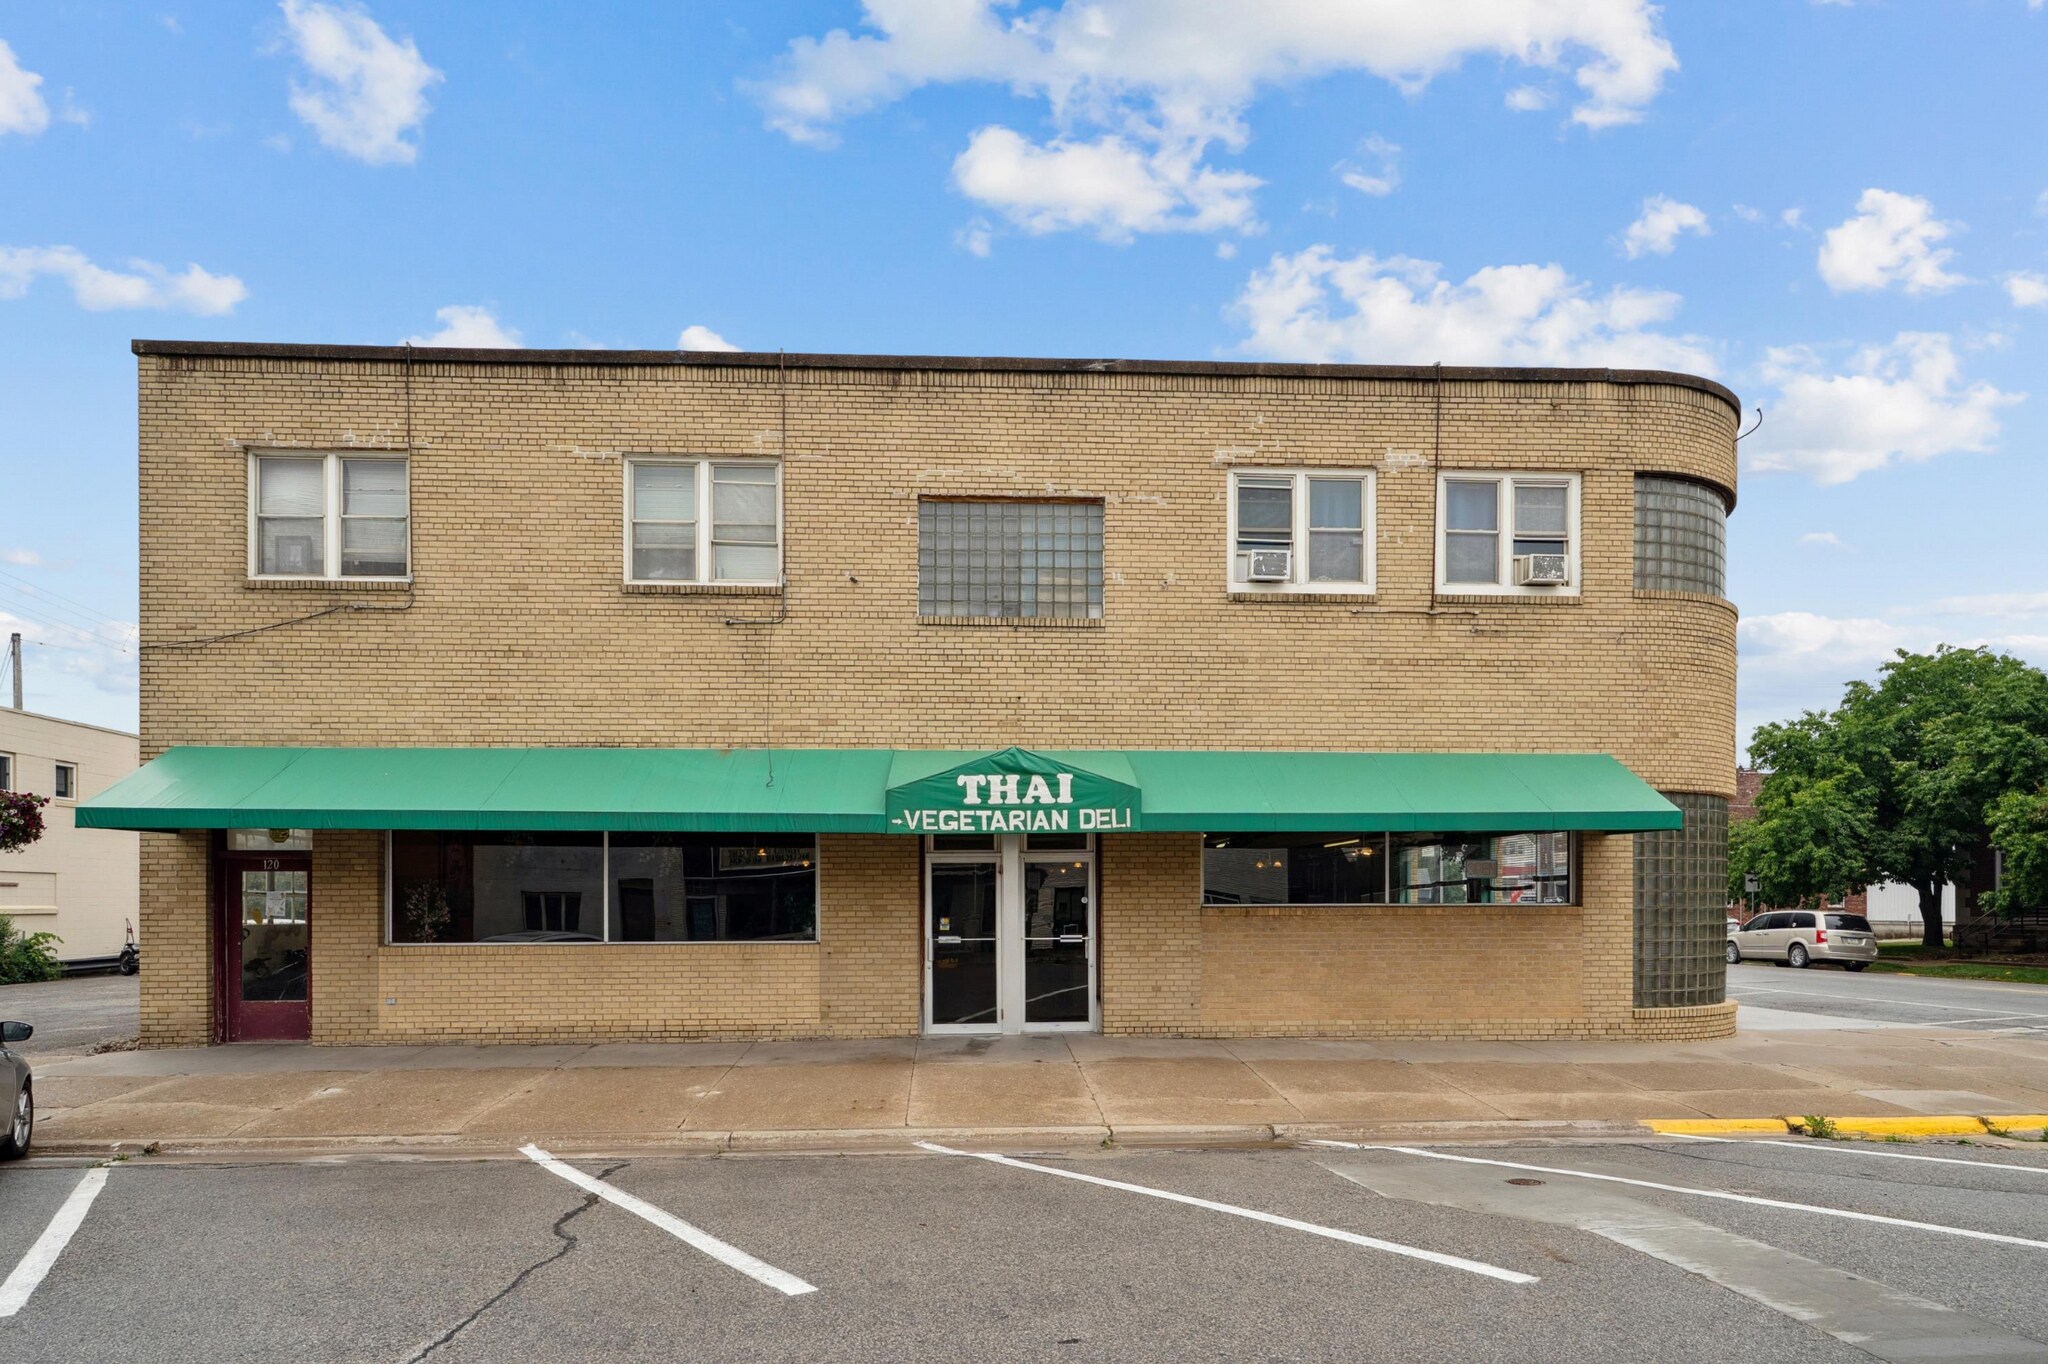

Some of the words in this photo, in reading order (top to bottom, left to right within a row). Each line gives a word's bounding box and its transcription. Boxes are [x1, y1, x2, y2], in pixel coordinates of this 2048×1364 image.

[957, 773, 1074, 804] THAI
[904, 809, 1068, 831] VEGETARIAN
[1079, 808, 1131, 830] DELI
[263, 859, 280, 871] 120
